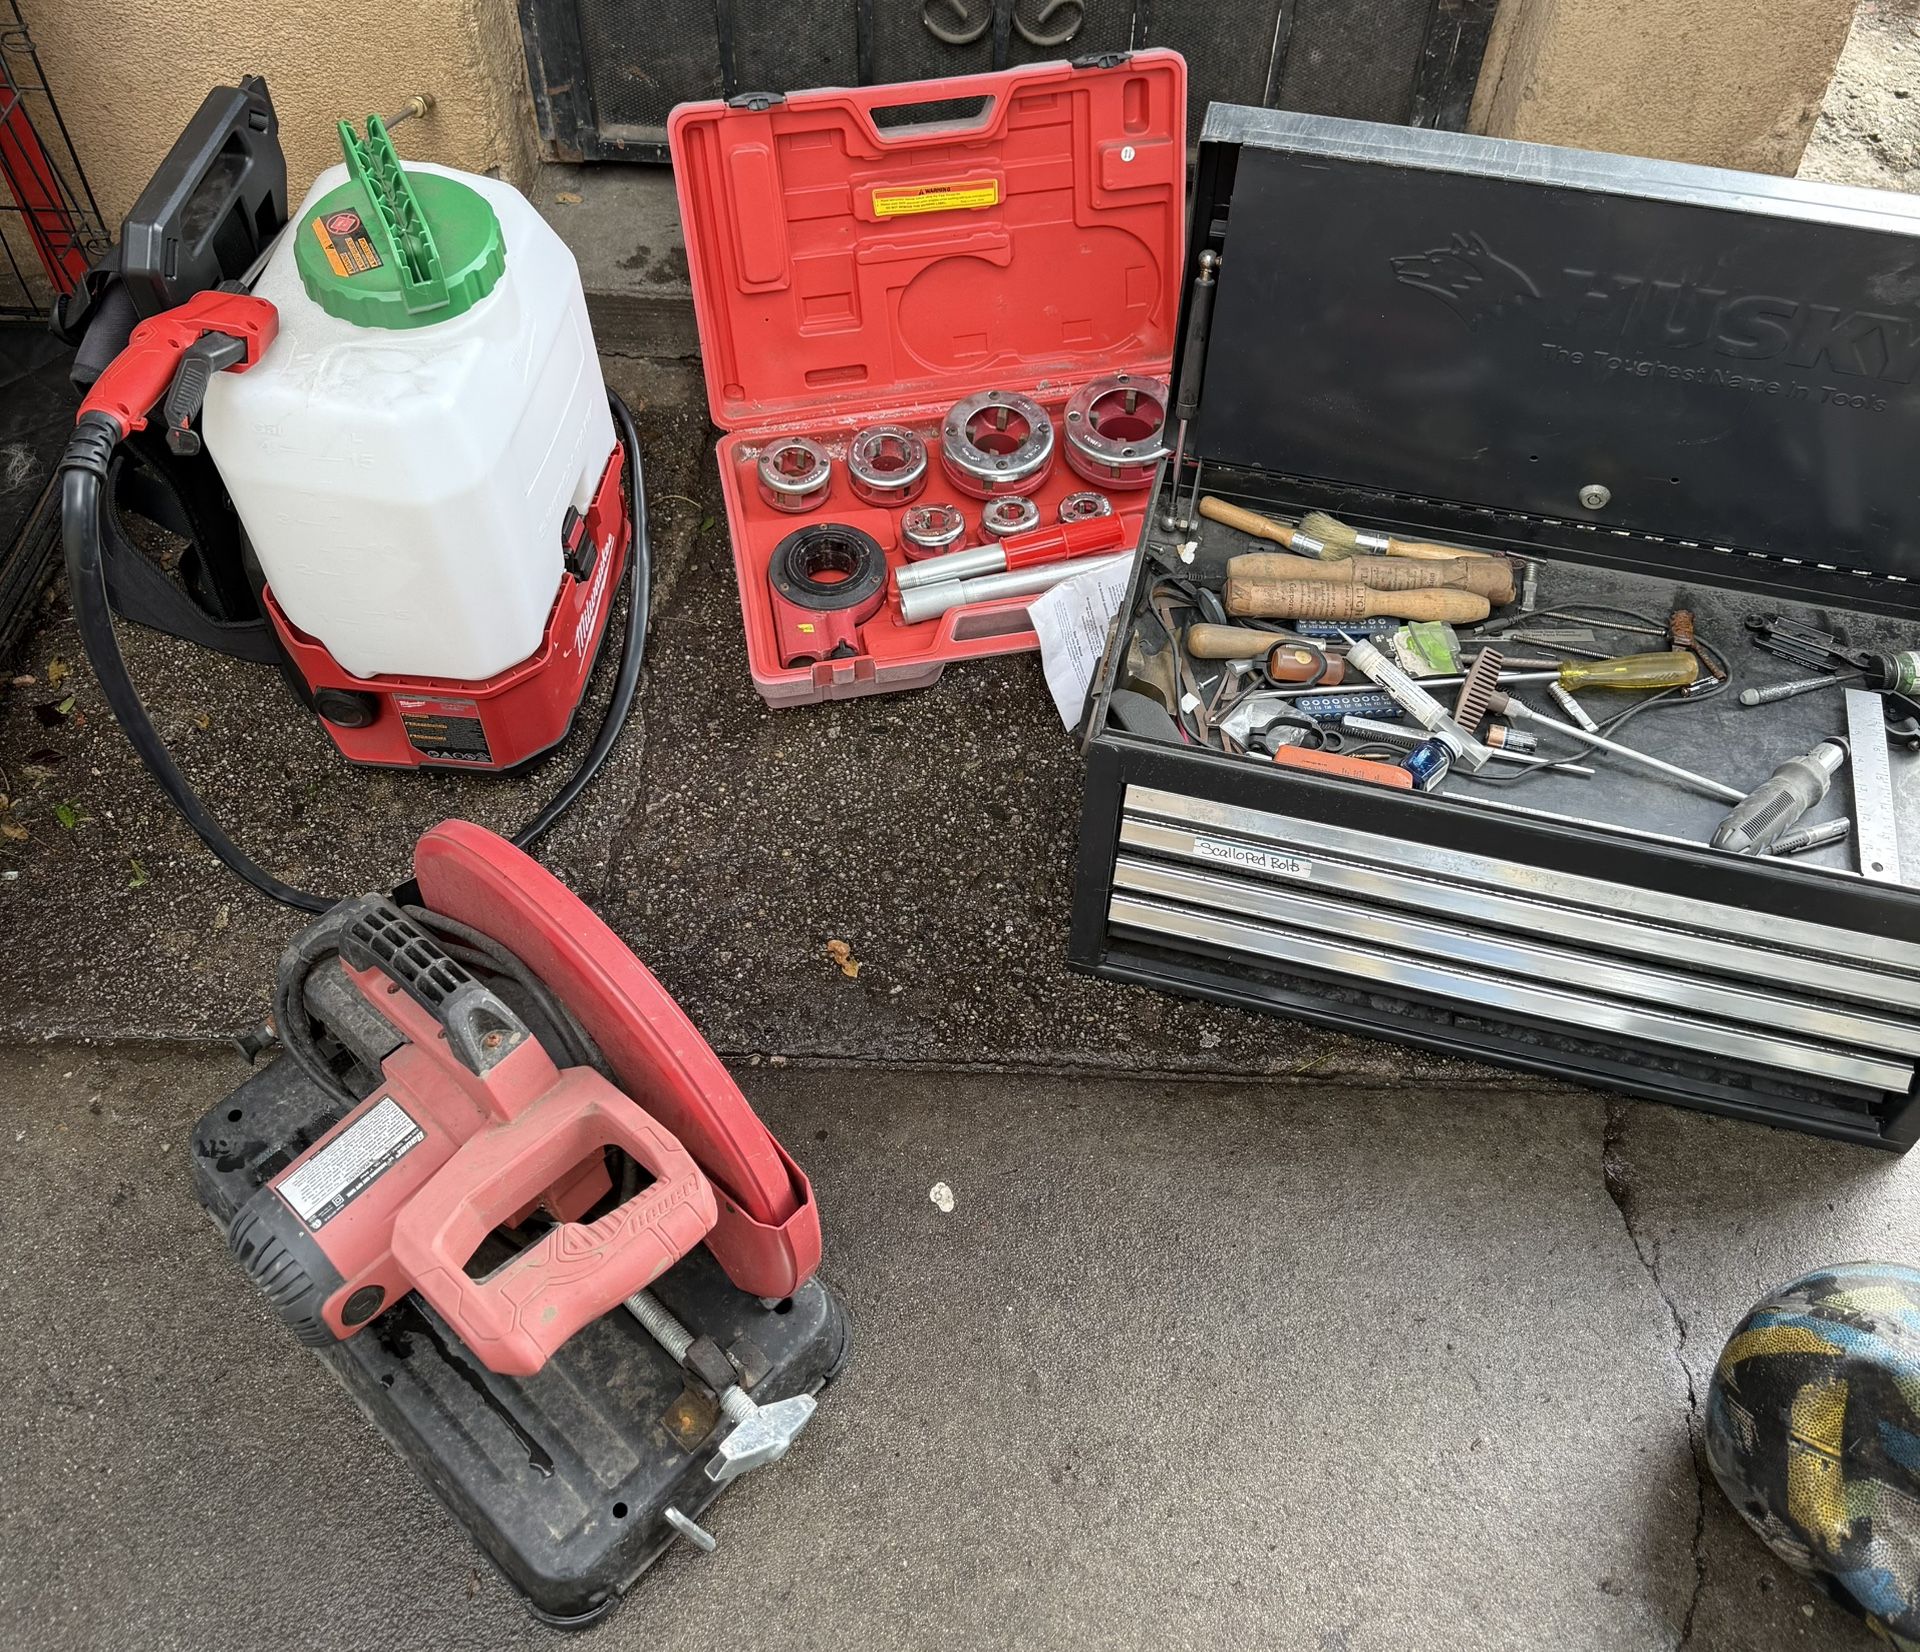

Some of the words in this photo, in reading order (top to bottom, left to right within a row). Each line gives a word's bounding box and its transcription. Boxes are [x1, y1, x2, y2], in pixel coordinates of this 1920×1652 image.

[925, 186, 951, 195] WARNING
[1555, 268, 1920, 384] HUSKY
[1541, 343, 1585, 365] The
[1594, 350, 1707, 384] Toughest
[1710, 367, 1781, 395] Name
[1821, 385, 1887, 413] Tools
[574, 532, 614, 658] Milwaukee
[1200, 842, 1266, 867] Scalloped
[1271, 857, 1300, 872] Bolts
[395, 1130, 425, 1159] Bauer
